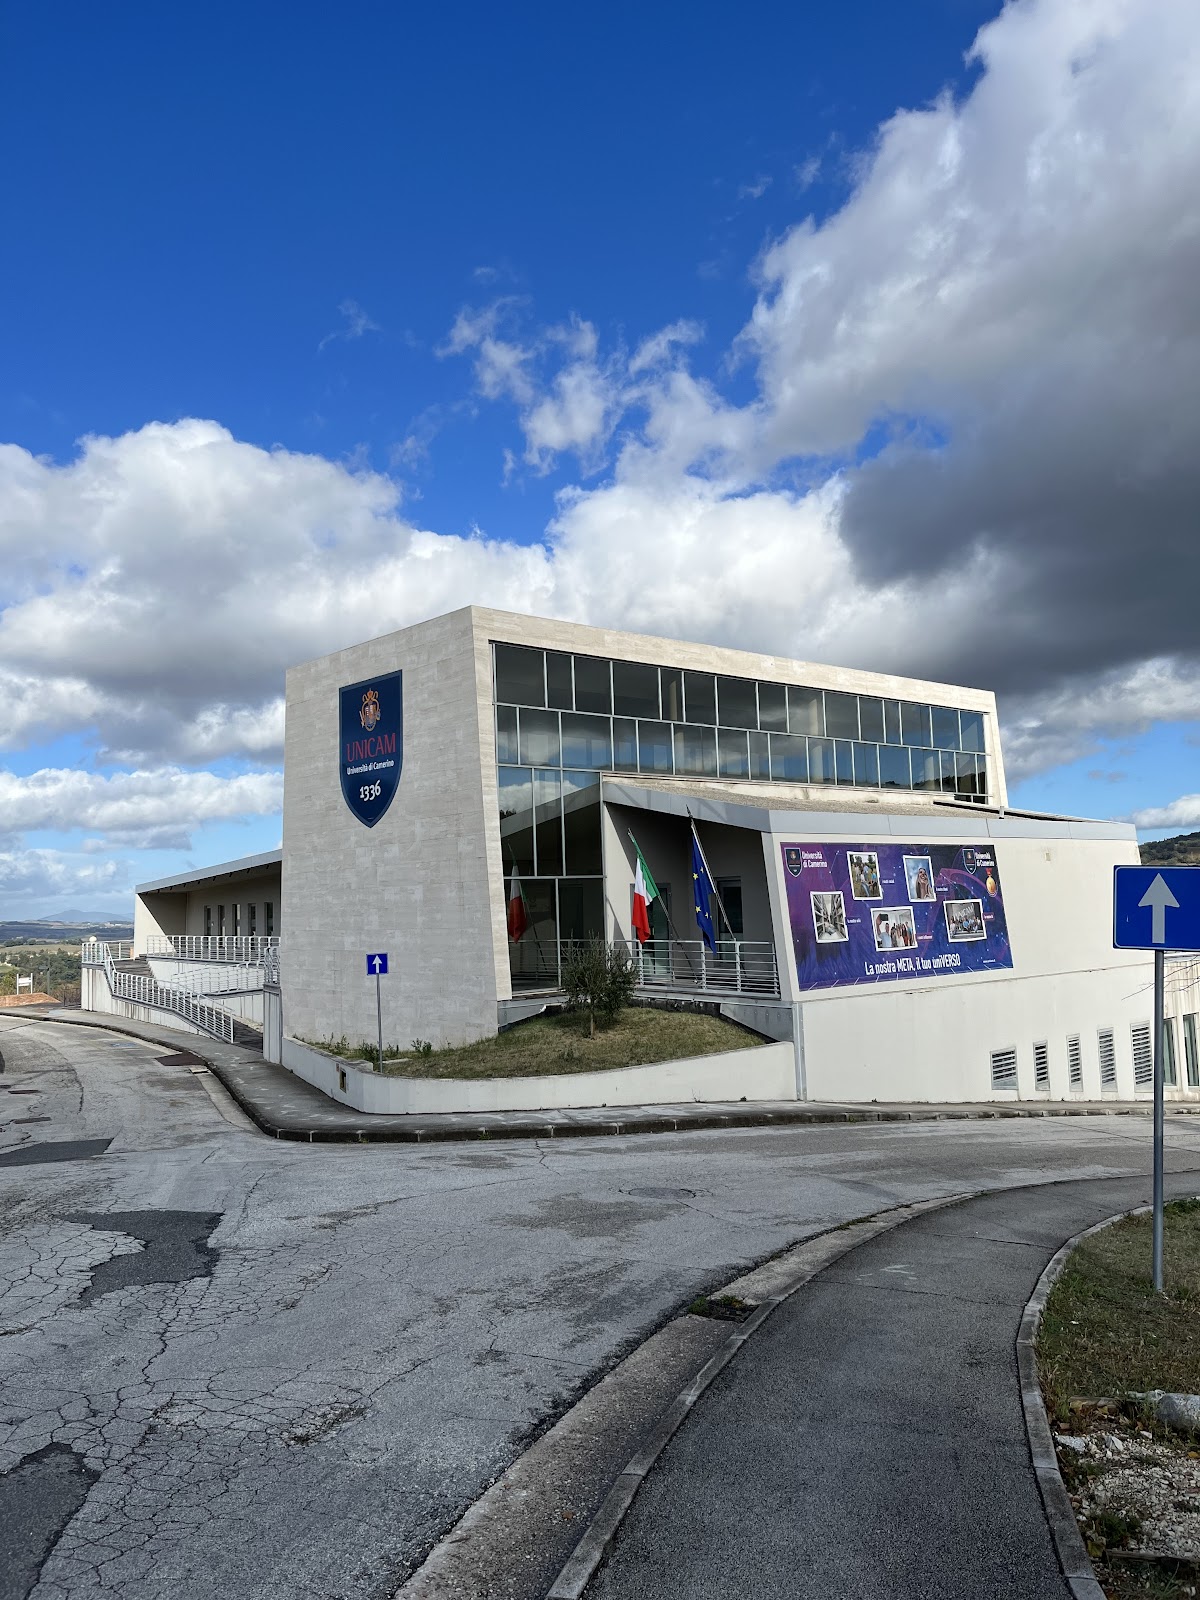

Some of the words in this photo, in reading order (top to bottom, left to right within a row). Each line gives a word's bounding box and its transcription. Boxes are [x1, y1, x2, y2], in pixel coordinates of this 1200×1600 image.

[347, 733, 396, 762] UNICAM
[347, 763, 368, 775] Università
[373, 759, 394, 770] Camerino
[360, 780, 381, 801] 1336
[802, 851, 823, 859] Università
[808, 860, 828, 868] Camerino
[864, 961, 875, 975] La
[875, 960, 897, 974] nostra
[896, 957, 916, 972] META,
[915, 956, 922, 970] il
[921, 957, 932, 970] tuo
[931, 953, 961, 969] uniVERSO
